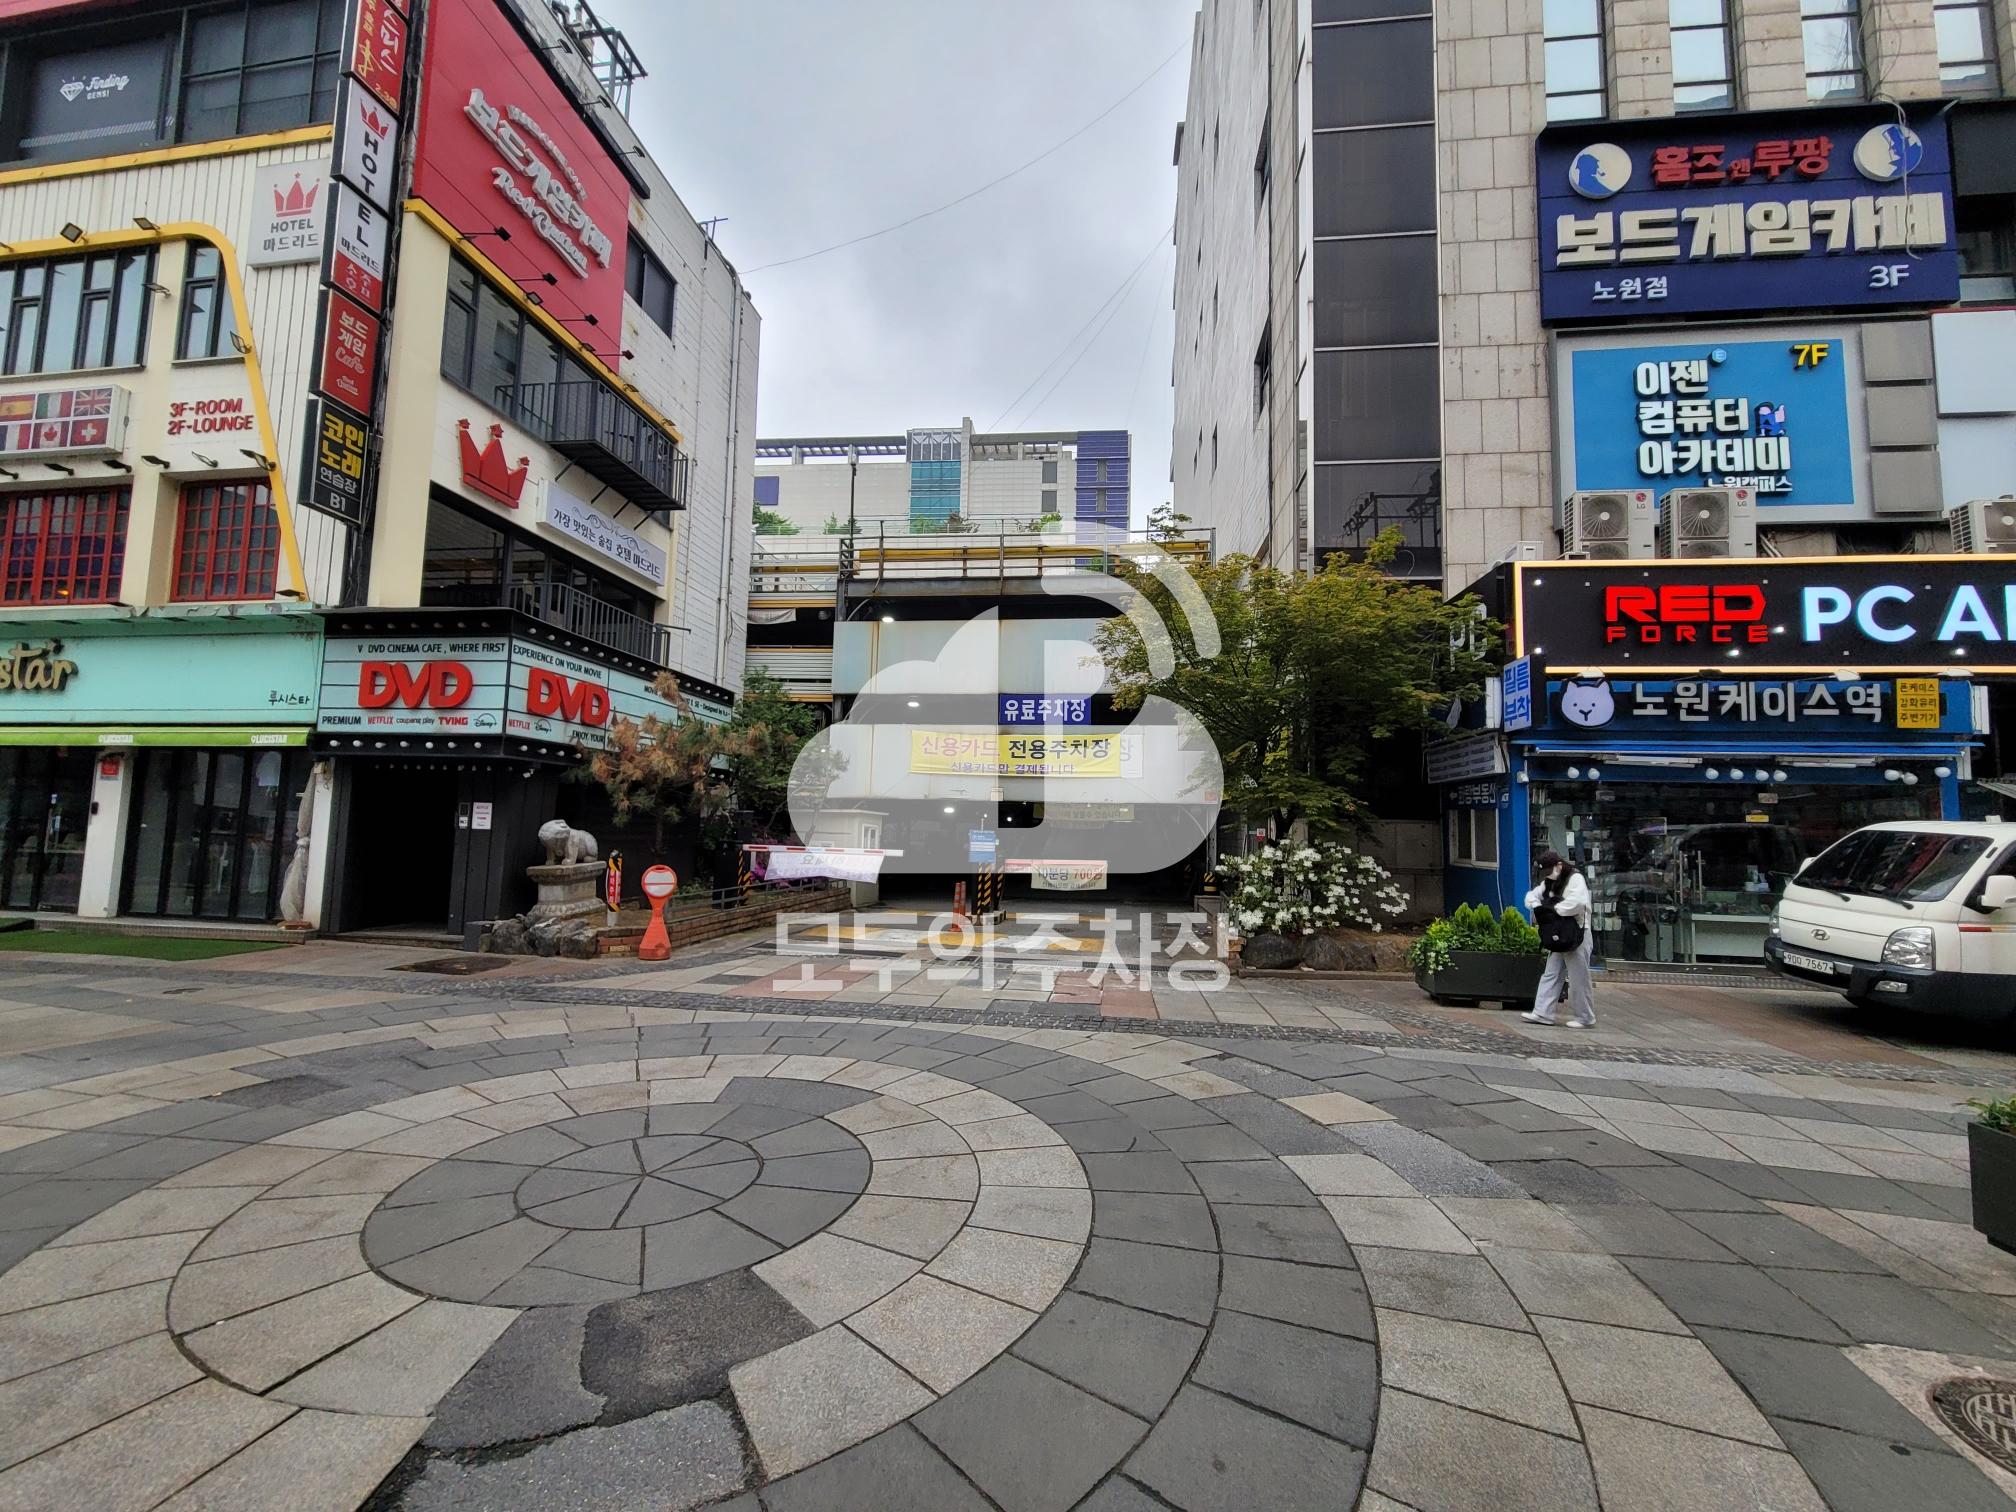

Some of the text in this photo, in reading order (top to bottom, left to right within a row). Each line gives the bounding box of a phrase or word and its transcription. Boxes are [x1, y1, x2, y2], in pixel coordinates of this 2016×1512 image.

[86, 74, 129, 91] Finding
[355, 131, 379, 248] HOTEL
[270, 218, 314, 233] HOTEL
[1556, 193, 1947, 266] 보드게임카페
[263, 233, 319, 252] 마드리드
[341, 236, 380, 274] 마드리드
[1593, 276, 1668, 300] 노원점
[1869, 264, 1909, 288] 3F
[340, 311, 368, 338] 보드
[338, 328, 366, 358] 게임
[1792, 343, 1830, 367] 7F
[335, 347, 365, 375] Cafe
[1635, 360, 1709, 395] 이젠
[170, 398, 243, 418] 3F-ROOM
[1638, 397, 1750, 435] 컴퓨터
[168, 415, 254, 435] 2F-LOUNGE
[323, 412, 364, 453] 코인
[320, 440, 363, 480] 노래
[1637, 437, 1791, 475] 아카데미
[320, 466, 358, 494] 연습장
[329, 491, 346, 512] B1
[553, 508, 661, 579] 가장 맛있는 술집 호텔 마드리드
[1606, 585, 1767, 622] RED
[1804, 585, 1917, 642] PC
[1607, 625, 1768, 643] FORCE
[368, 643, 385, 653] DVD
[387, 643, 420, 653] CINEMA
[450, 643, 480, 653] WHERE
[482, 642, 506, 652] FIRST
[513, 644, 602, 679] EXPERIENCE ON YOUR MOVIE
[358, 660, 474, 709] DVD
[1504, 661, 1529, 696] 필름
[268, 690, 310, 706] 루시스타
[527, 666, 610, 725] DVD
[1632, 681, 1883, 723] 노원케이스역
[1900, 697, 1936, 708] 강화유리
[321, 716, 361, 725] PREMIUM
[367, 716, 394, 725] NETFLIX
[438, 716, 468, 726] TVING
[1004, 700, 1086, 721] 유료주차장
[1504, 694, 1530, 726] 부착
[1900, 713, 1936, 723] 주변기기
[508, 719, 531, 730] NETFLIX
[921, 736, 1110, 760] 신용카드 전용주차장
[951, 763, 1010, 774] 신용카드만
[1805, 958, 1828, 971] 7567
